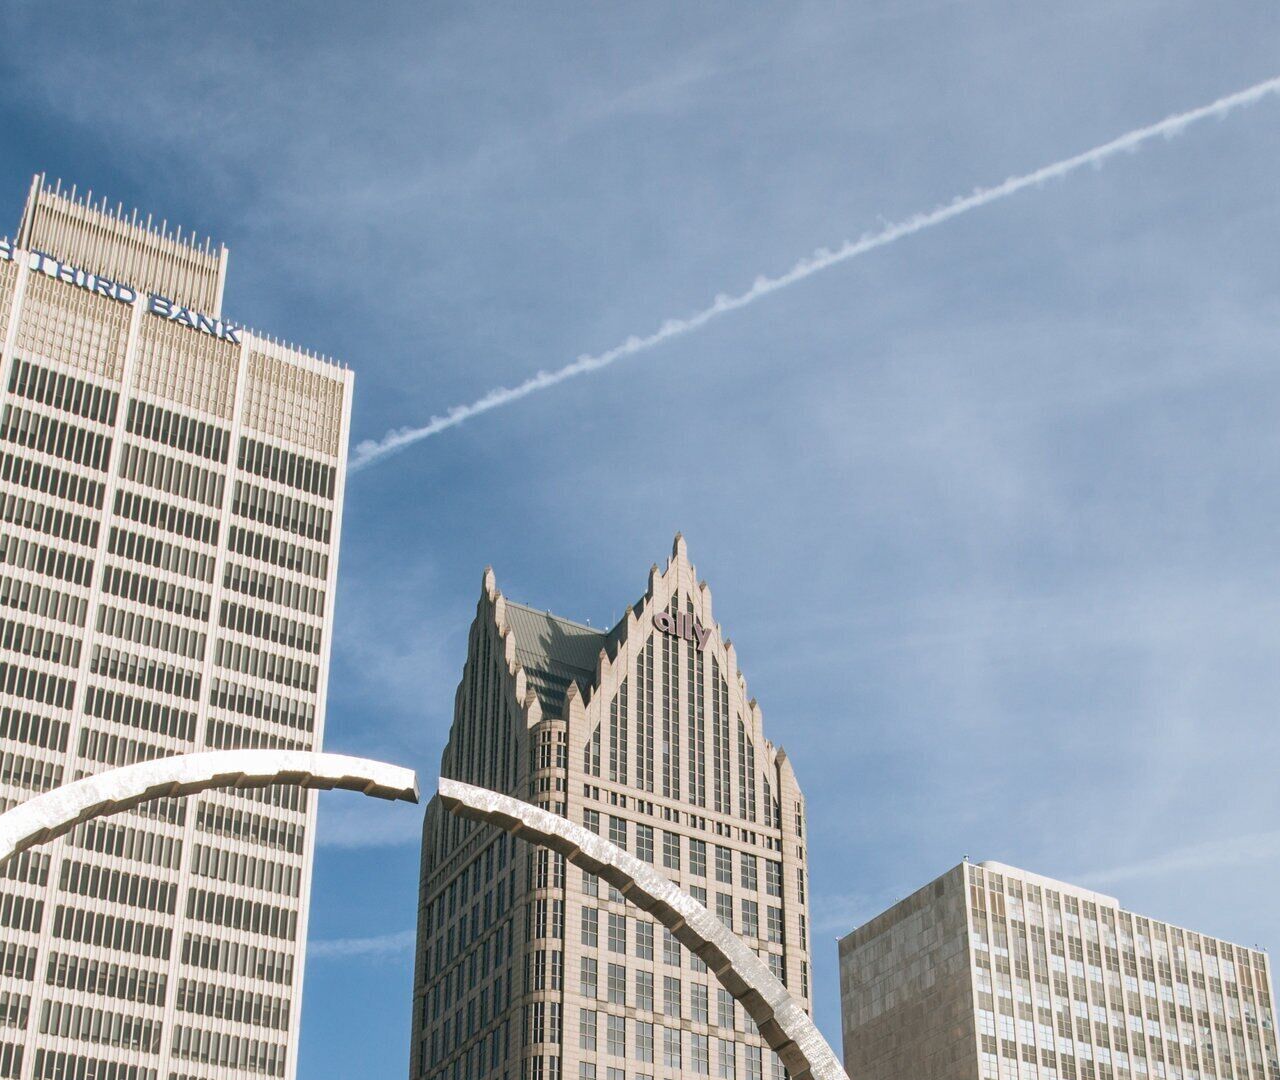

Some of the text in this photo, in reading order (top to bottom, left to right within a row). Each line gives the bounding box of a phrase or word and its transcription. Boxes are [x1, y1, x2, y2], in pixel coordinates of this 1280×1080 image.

[29, 249, 138, 306] THIRD
[147, 293, 243, 345] BANK
[652, 610, 713, 652] ally
